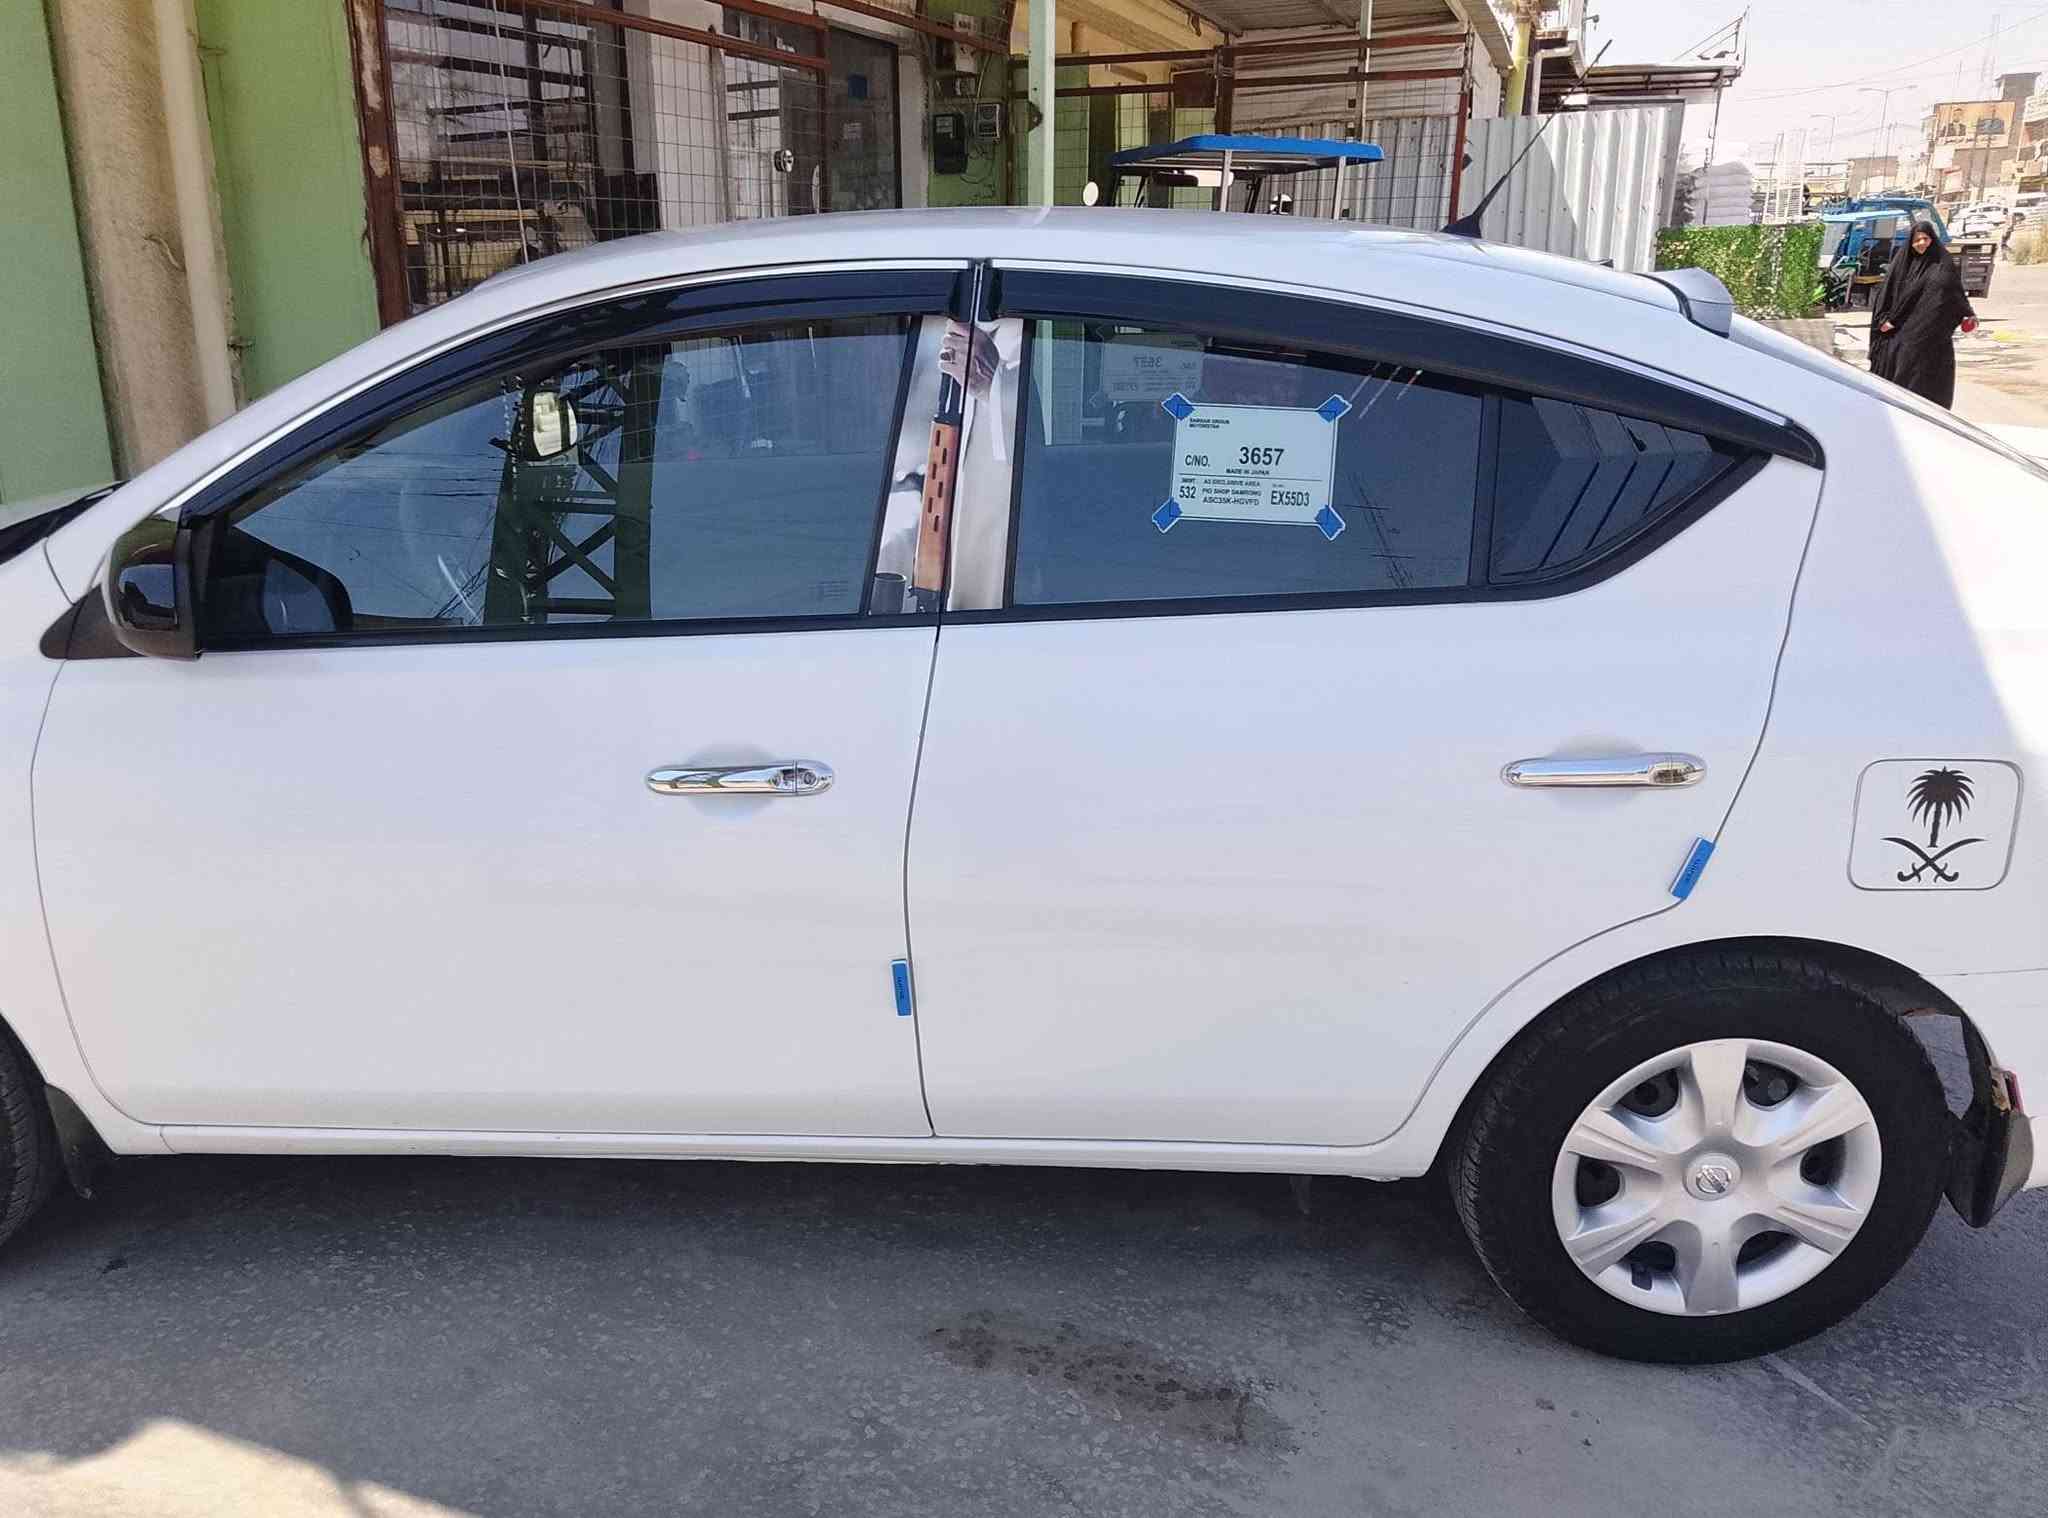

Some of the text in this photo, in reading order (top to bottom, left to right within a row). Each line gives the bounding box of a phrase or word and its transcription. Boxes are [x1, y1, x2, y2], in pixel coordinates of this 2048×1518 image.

[1184, 446, 1285, 468] C/NO. 3657
[1179, 485, 1197, 499] 532
[1270, 490, 1310, 506] EX55D3
